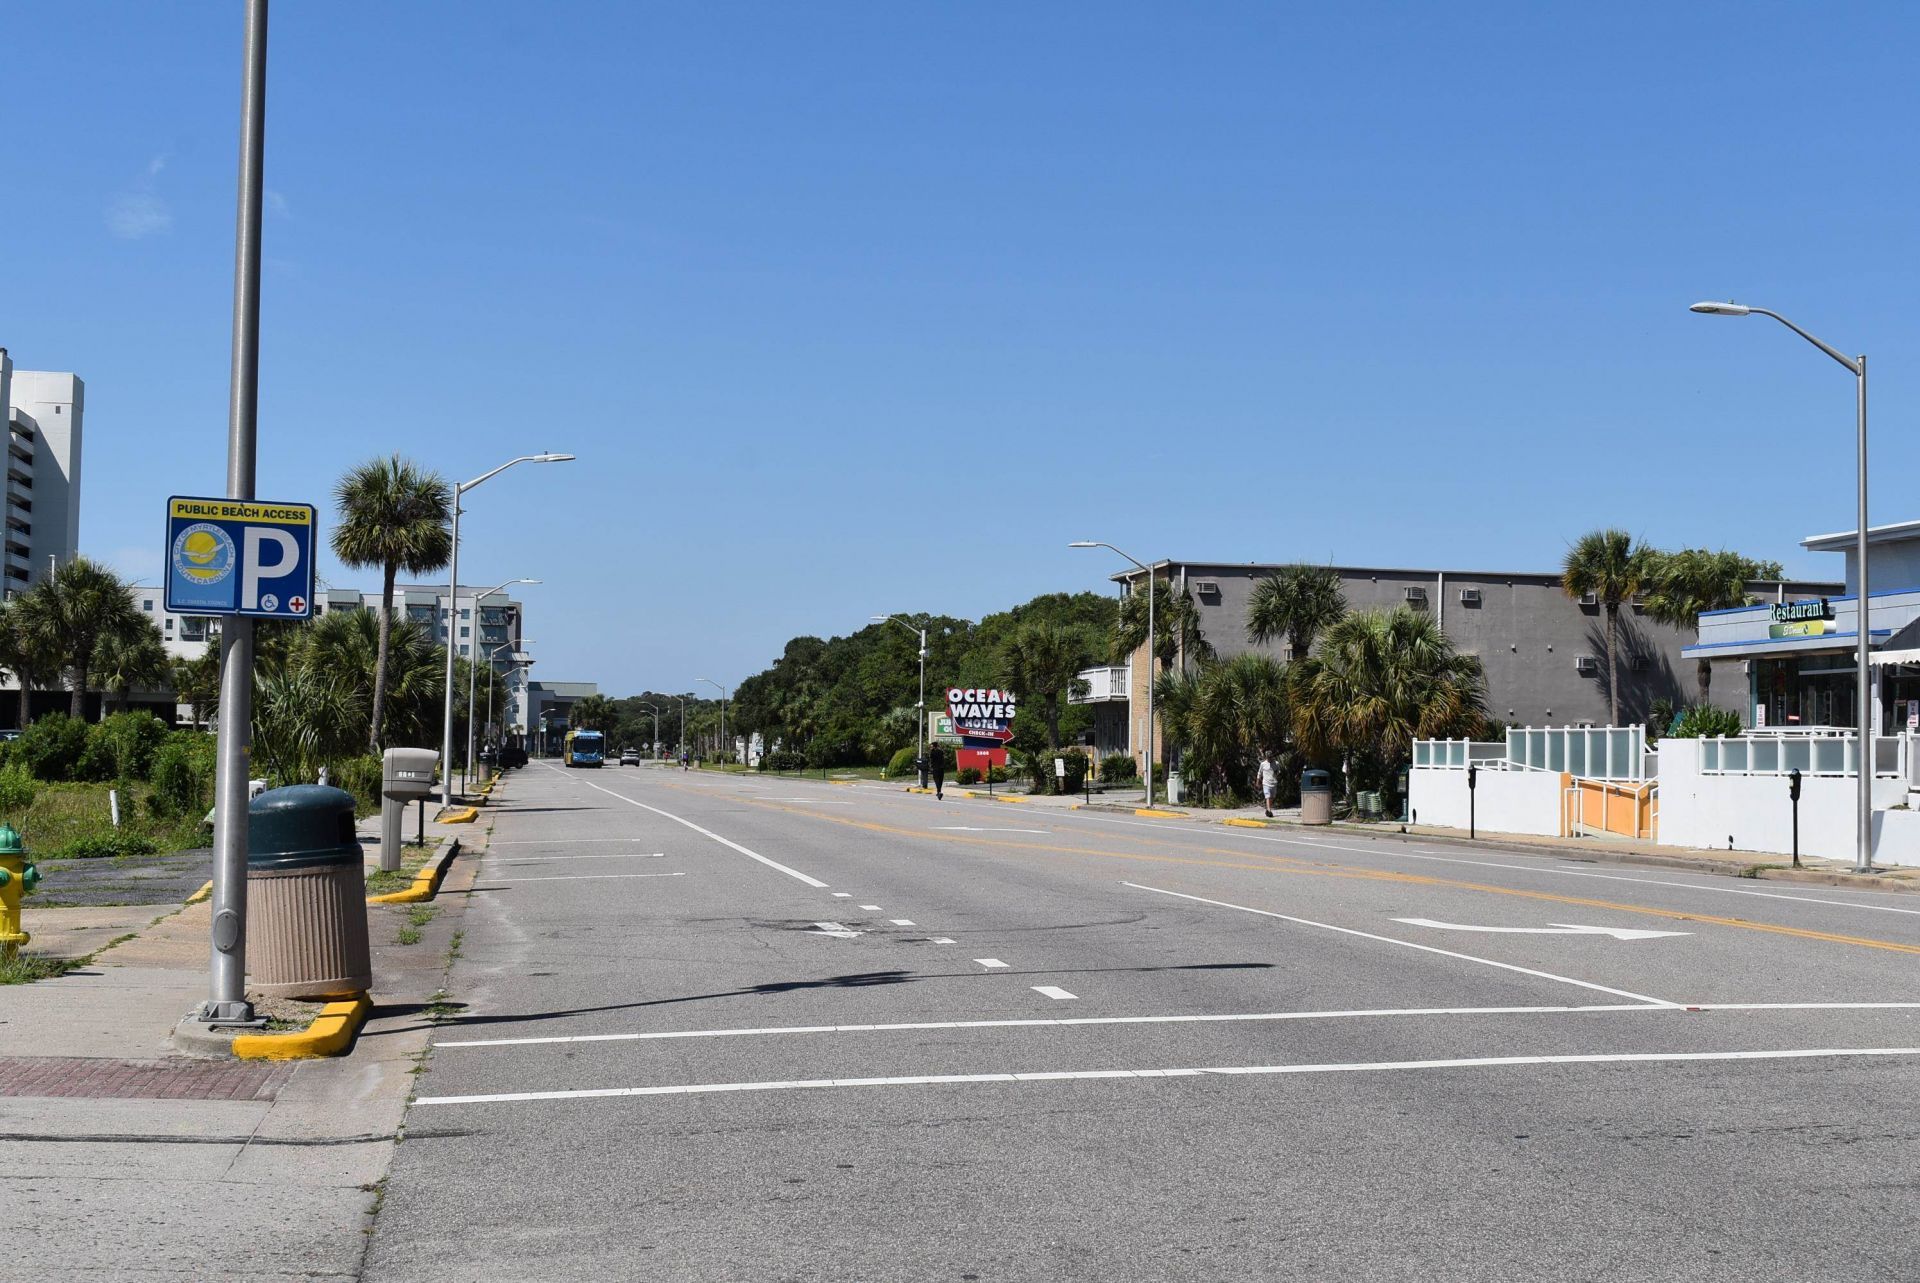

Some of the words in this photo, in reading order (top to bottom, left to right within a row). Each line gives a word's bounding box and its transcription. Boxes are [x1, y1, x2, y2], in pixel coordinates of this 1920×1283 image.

[177, 504, 219, 515] PUBLIC
[221, 506, 259, 517] BEACH
[262, 509, 306, 520] ACCESS
[190, 523, 221, 534] MYRTLE
[219, 530, 235, 559] BEACH
[175, 559, 197, 583] SOUTH
[197, 562, 234, 584] CAROLINA
[241, 526, 300, 609] P
[1769, 600, 1824, 621] Restaurant
[948, 688, 1016, 703] OCEAN
[950, 704, 1016, 718] WAVES
[964, 719, 999, 730] HOTEL
